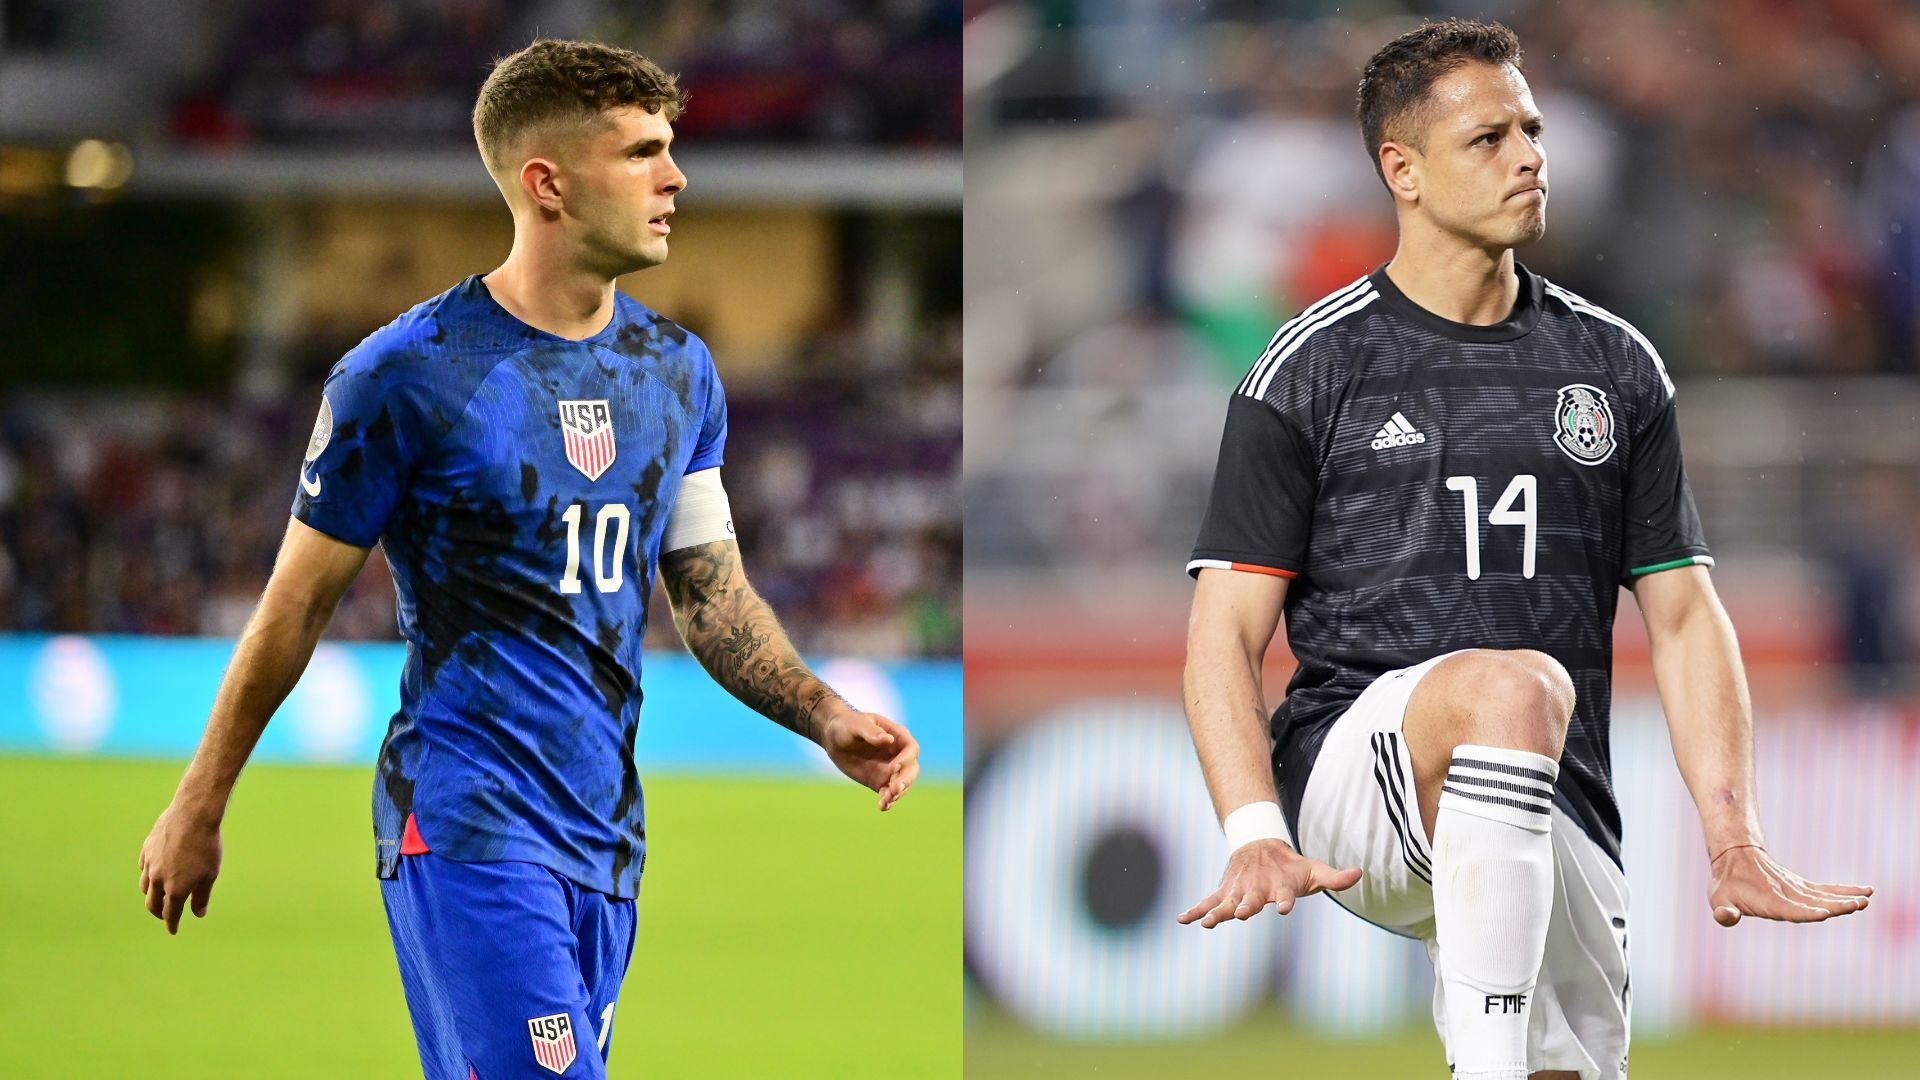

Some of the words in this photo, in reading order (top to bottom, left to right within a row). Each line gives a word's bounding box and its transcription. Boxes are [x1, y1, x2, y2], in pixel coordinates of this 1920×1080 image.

[562, 404, 608, 434] USA
[1371, 432, 1426, 450] adidas
[1446, 474, 1537, 581] 14
[559, 503, 631, 594] 10
[1485, 994, 1527, 1014] FMF
[531, 1016, 569, 1041] USA
